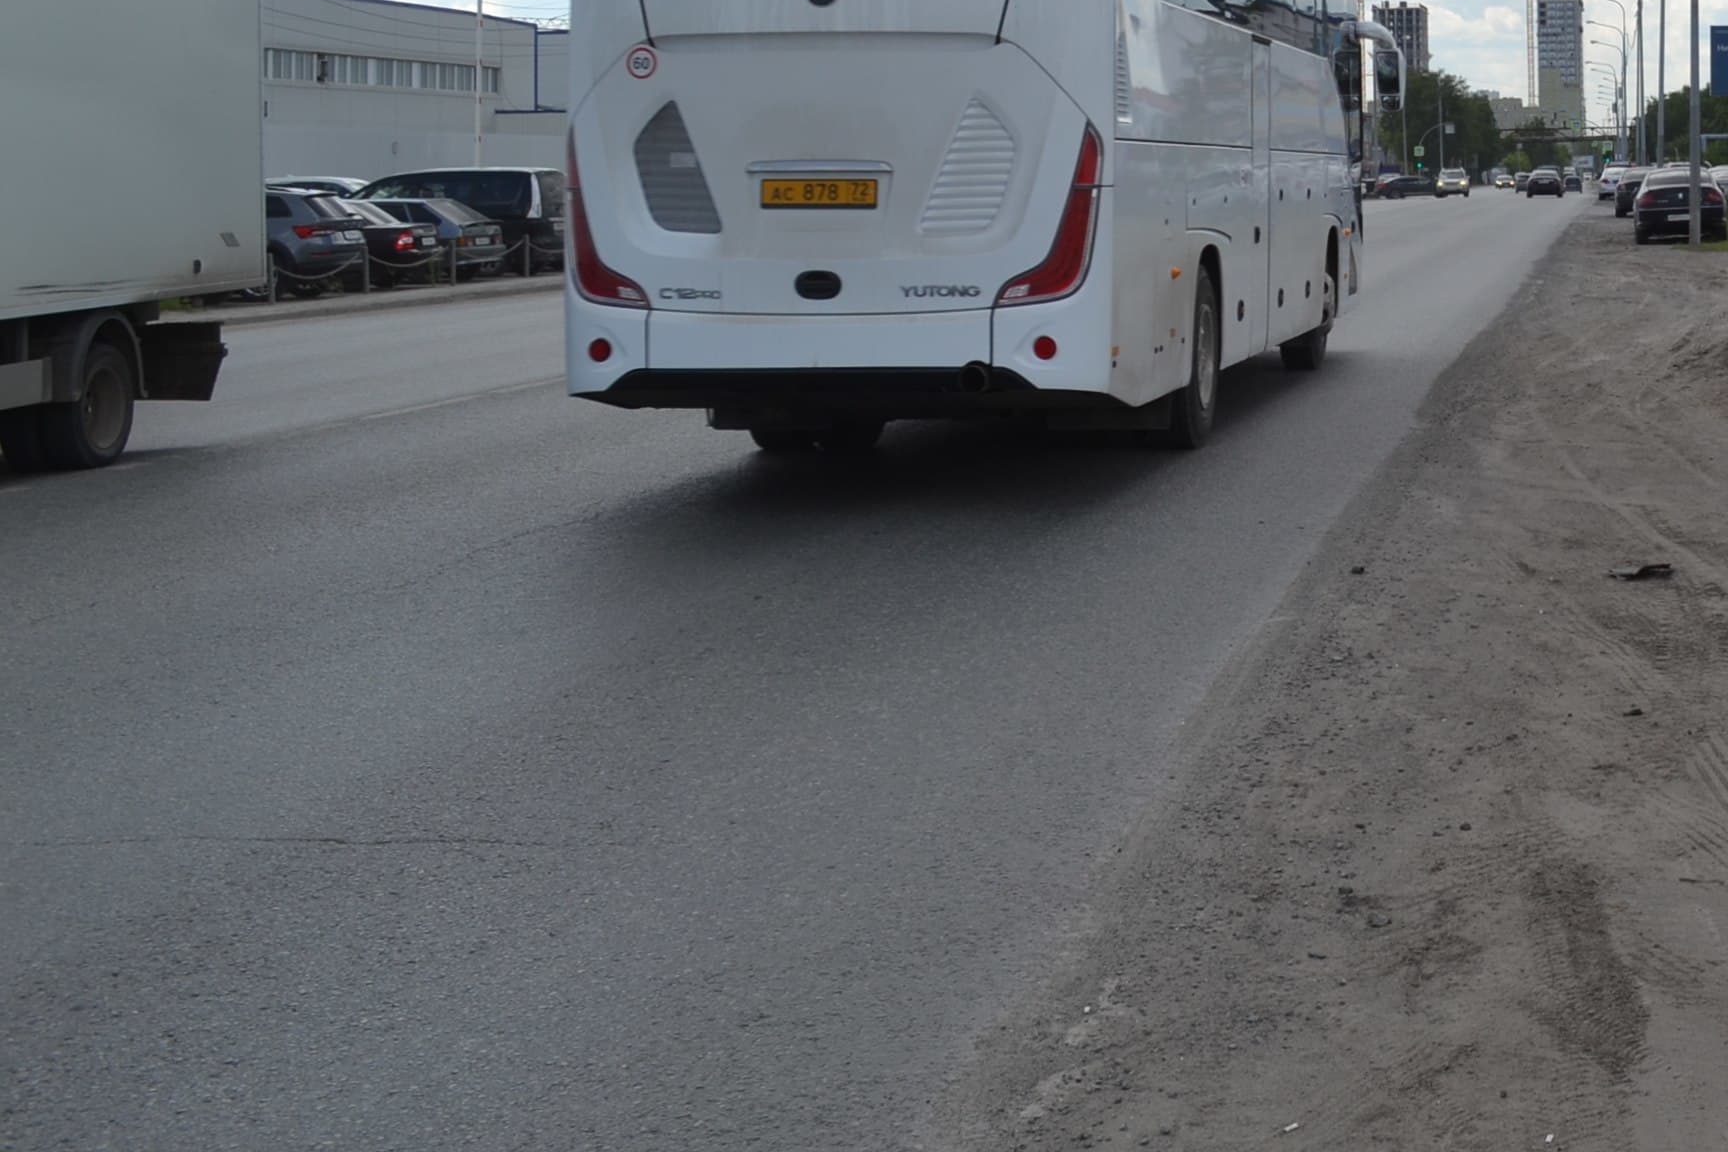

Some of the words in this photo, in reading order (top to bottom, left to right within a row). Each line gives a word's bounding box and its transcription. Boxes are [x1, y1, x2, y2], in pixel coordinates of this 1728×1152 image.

[633, 56, 650, 70] 60
[803, 183, 839, 201] 878
[900, 284, 982, 298] YUTONG
